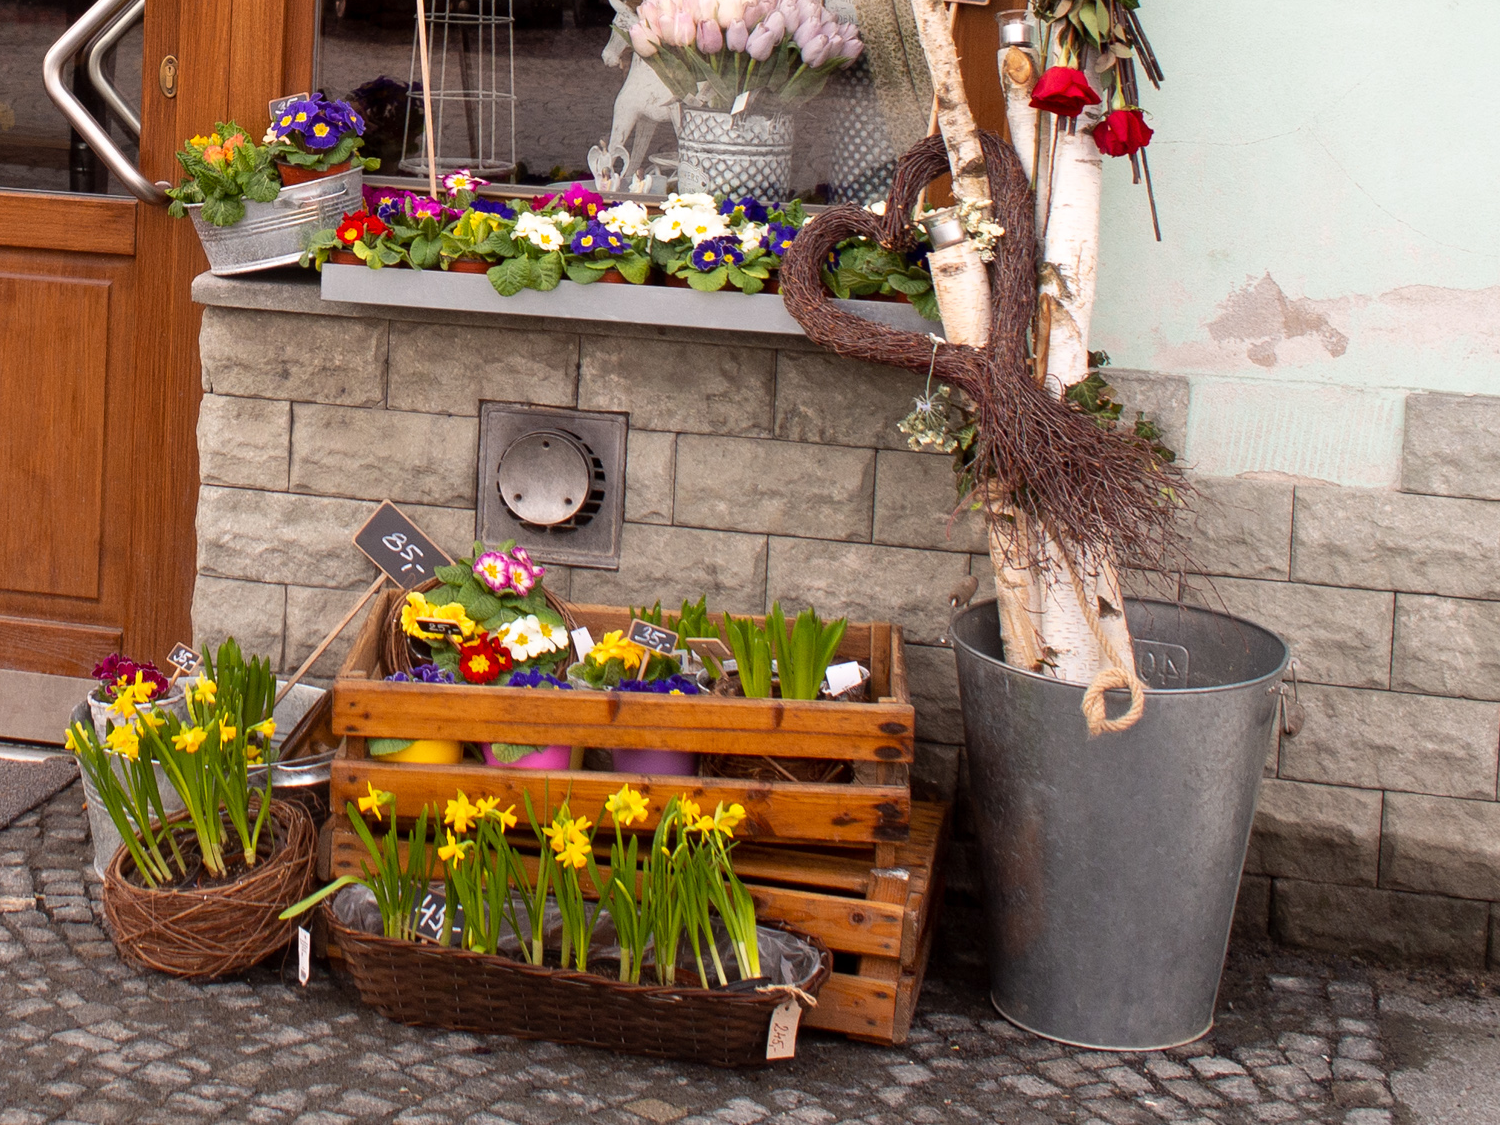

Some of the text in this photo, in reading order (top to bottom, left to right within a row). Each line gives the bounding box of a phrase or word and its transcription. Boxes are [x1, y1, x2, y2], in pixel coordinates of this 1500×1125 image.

[382, 532, 425, 573] 85,-
[429, 622, 460, 635] 25,-
[634, 626, 671, 652] 35,-
